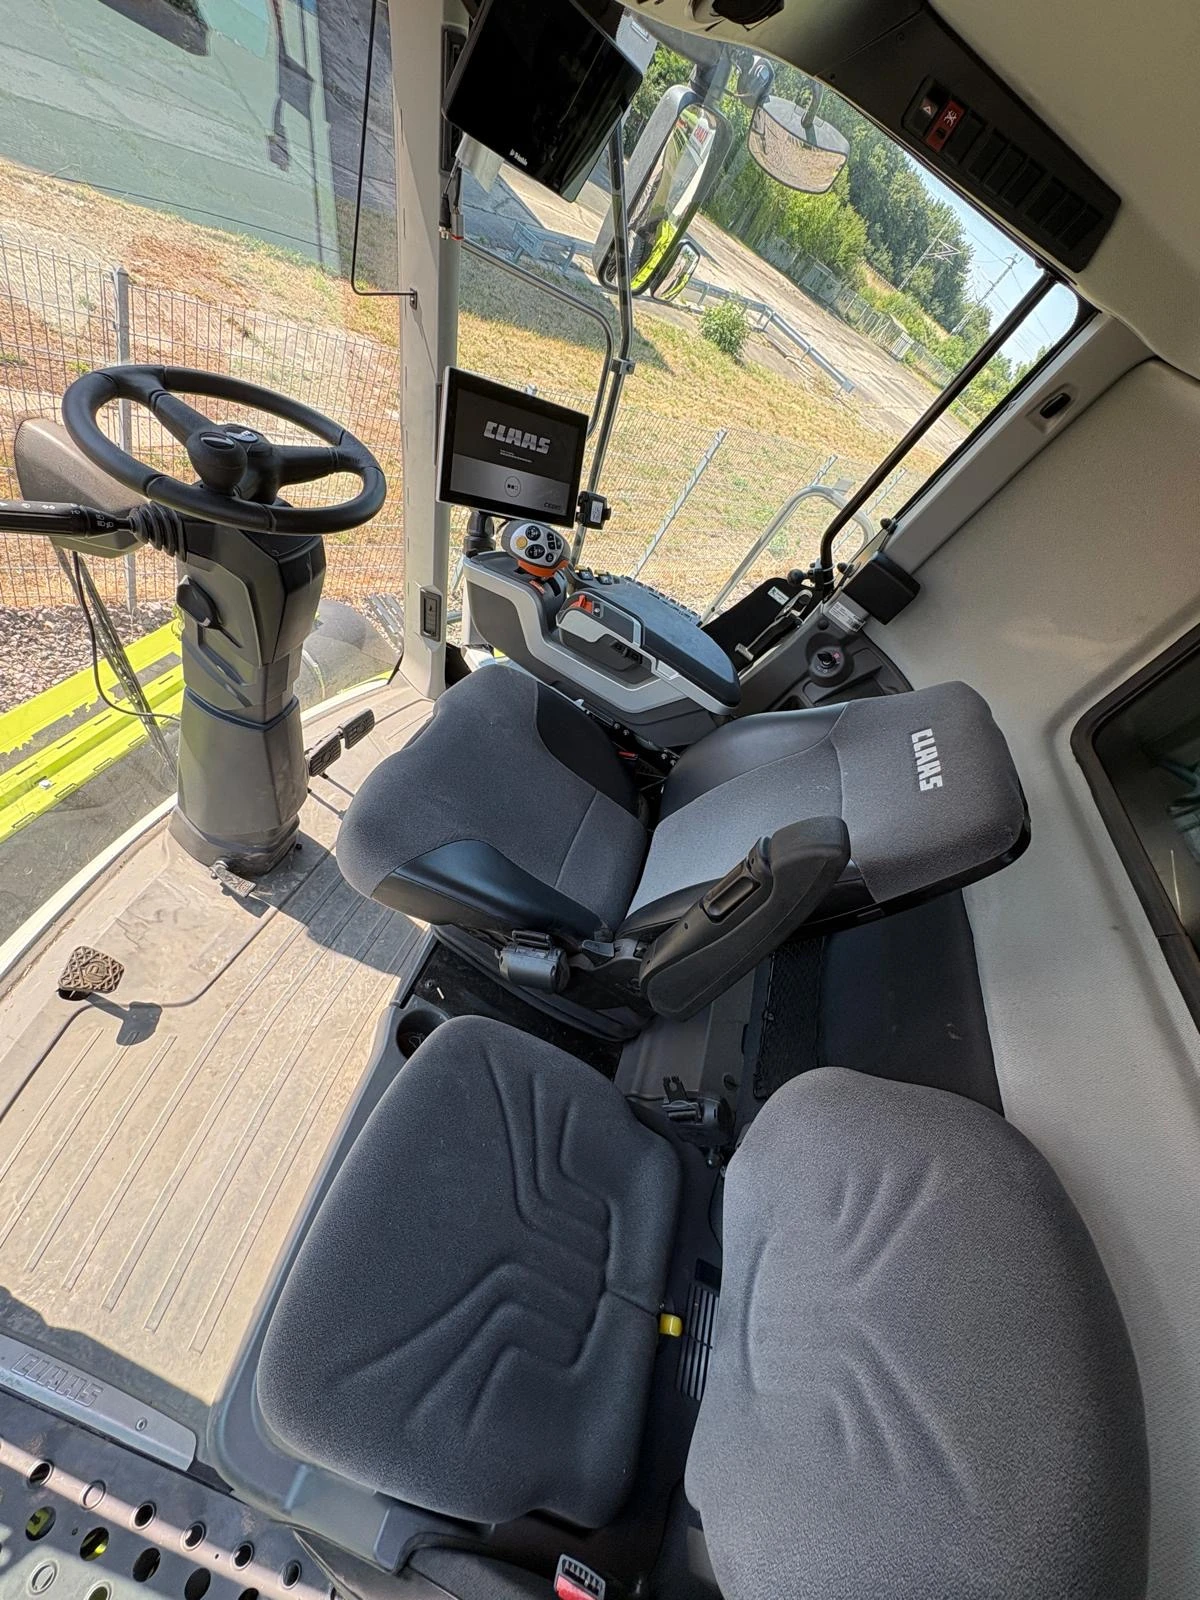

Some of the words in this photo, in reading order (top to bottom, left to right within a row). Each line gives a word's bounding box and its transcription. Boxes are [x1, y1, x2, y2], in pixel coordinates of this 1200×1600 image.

[483, 421, 551, 454] CLAAS
[911, 728, 943, 791] CLAAS
[11, 1352, 104, 1407] CLAAS
